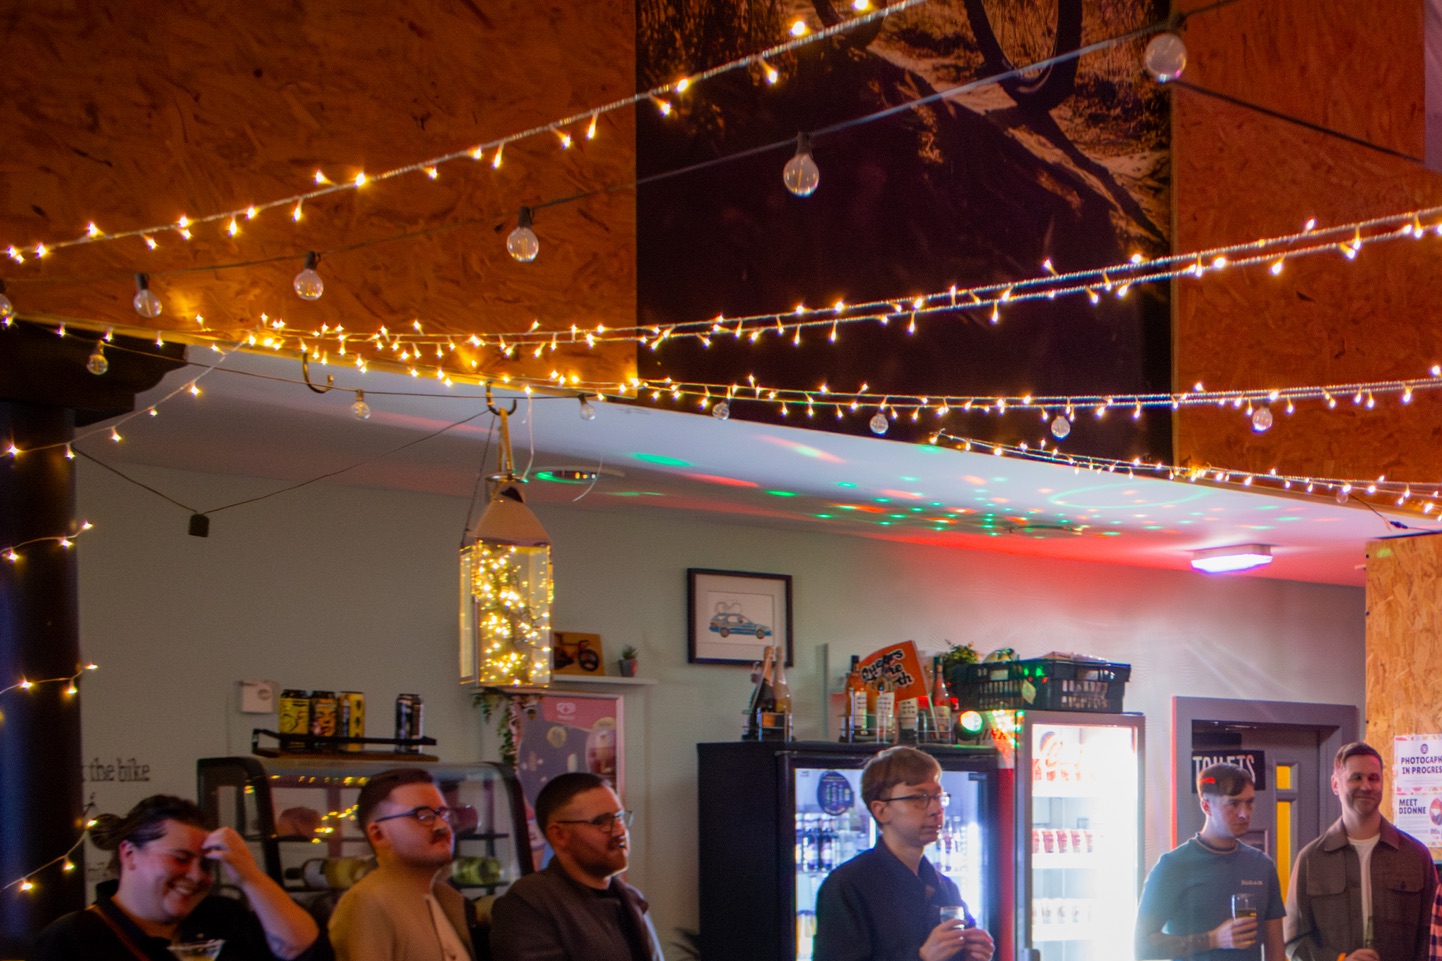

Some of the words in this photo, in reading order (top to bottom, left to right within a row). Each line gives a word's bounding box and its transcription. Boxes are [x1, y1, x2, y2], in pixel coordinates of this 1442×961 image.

[89, 757, 115, 782] the
[117, 757, 151, 782] bike
[1402, 767, 1410, 775] IN
[1398, 798, 1418, 807] MEET
[1398, 806, 1427, 815] DIONNE
